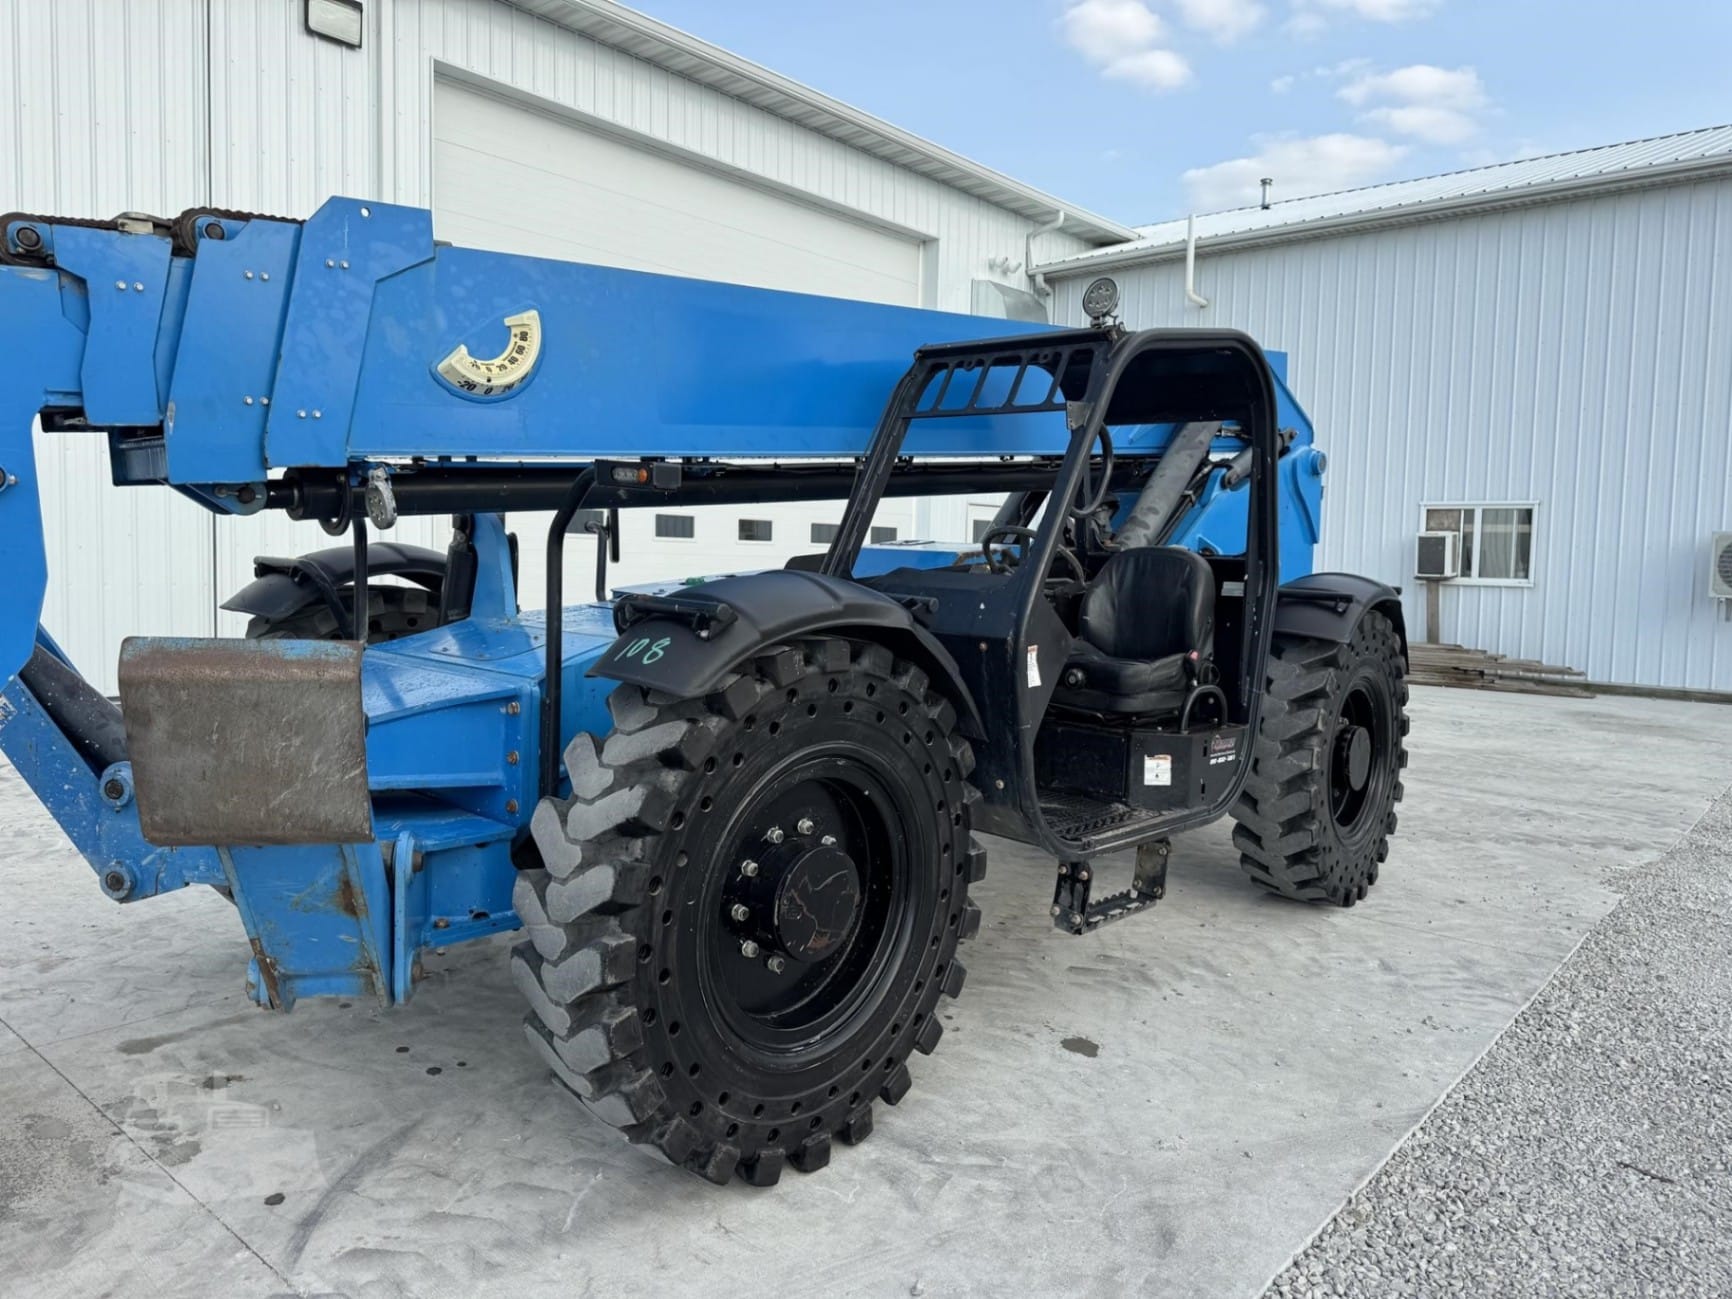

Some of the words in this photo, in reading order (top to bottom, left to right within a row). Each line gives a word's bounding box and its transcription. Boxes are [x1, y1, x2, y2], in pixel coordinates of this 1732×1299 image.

[519, 331, 529, 342] 80
[515, 344, 526, 355] 60
[507, 355, 519, 365] 40
[496, 363, 508, 372] 20
[457, 380, 477, 392] -20
[483, 387, 494, 395] 0
[614, 637, 671, 665] 108
